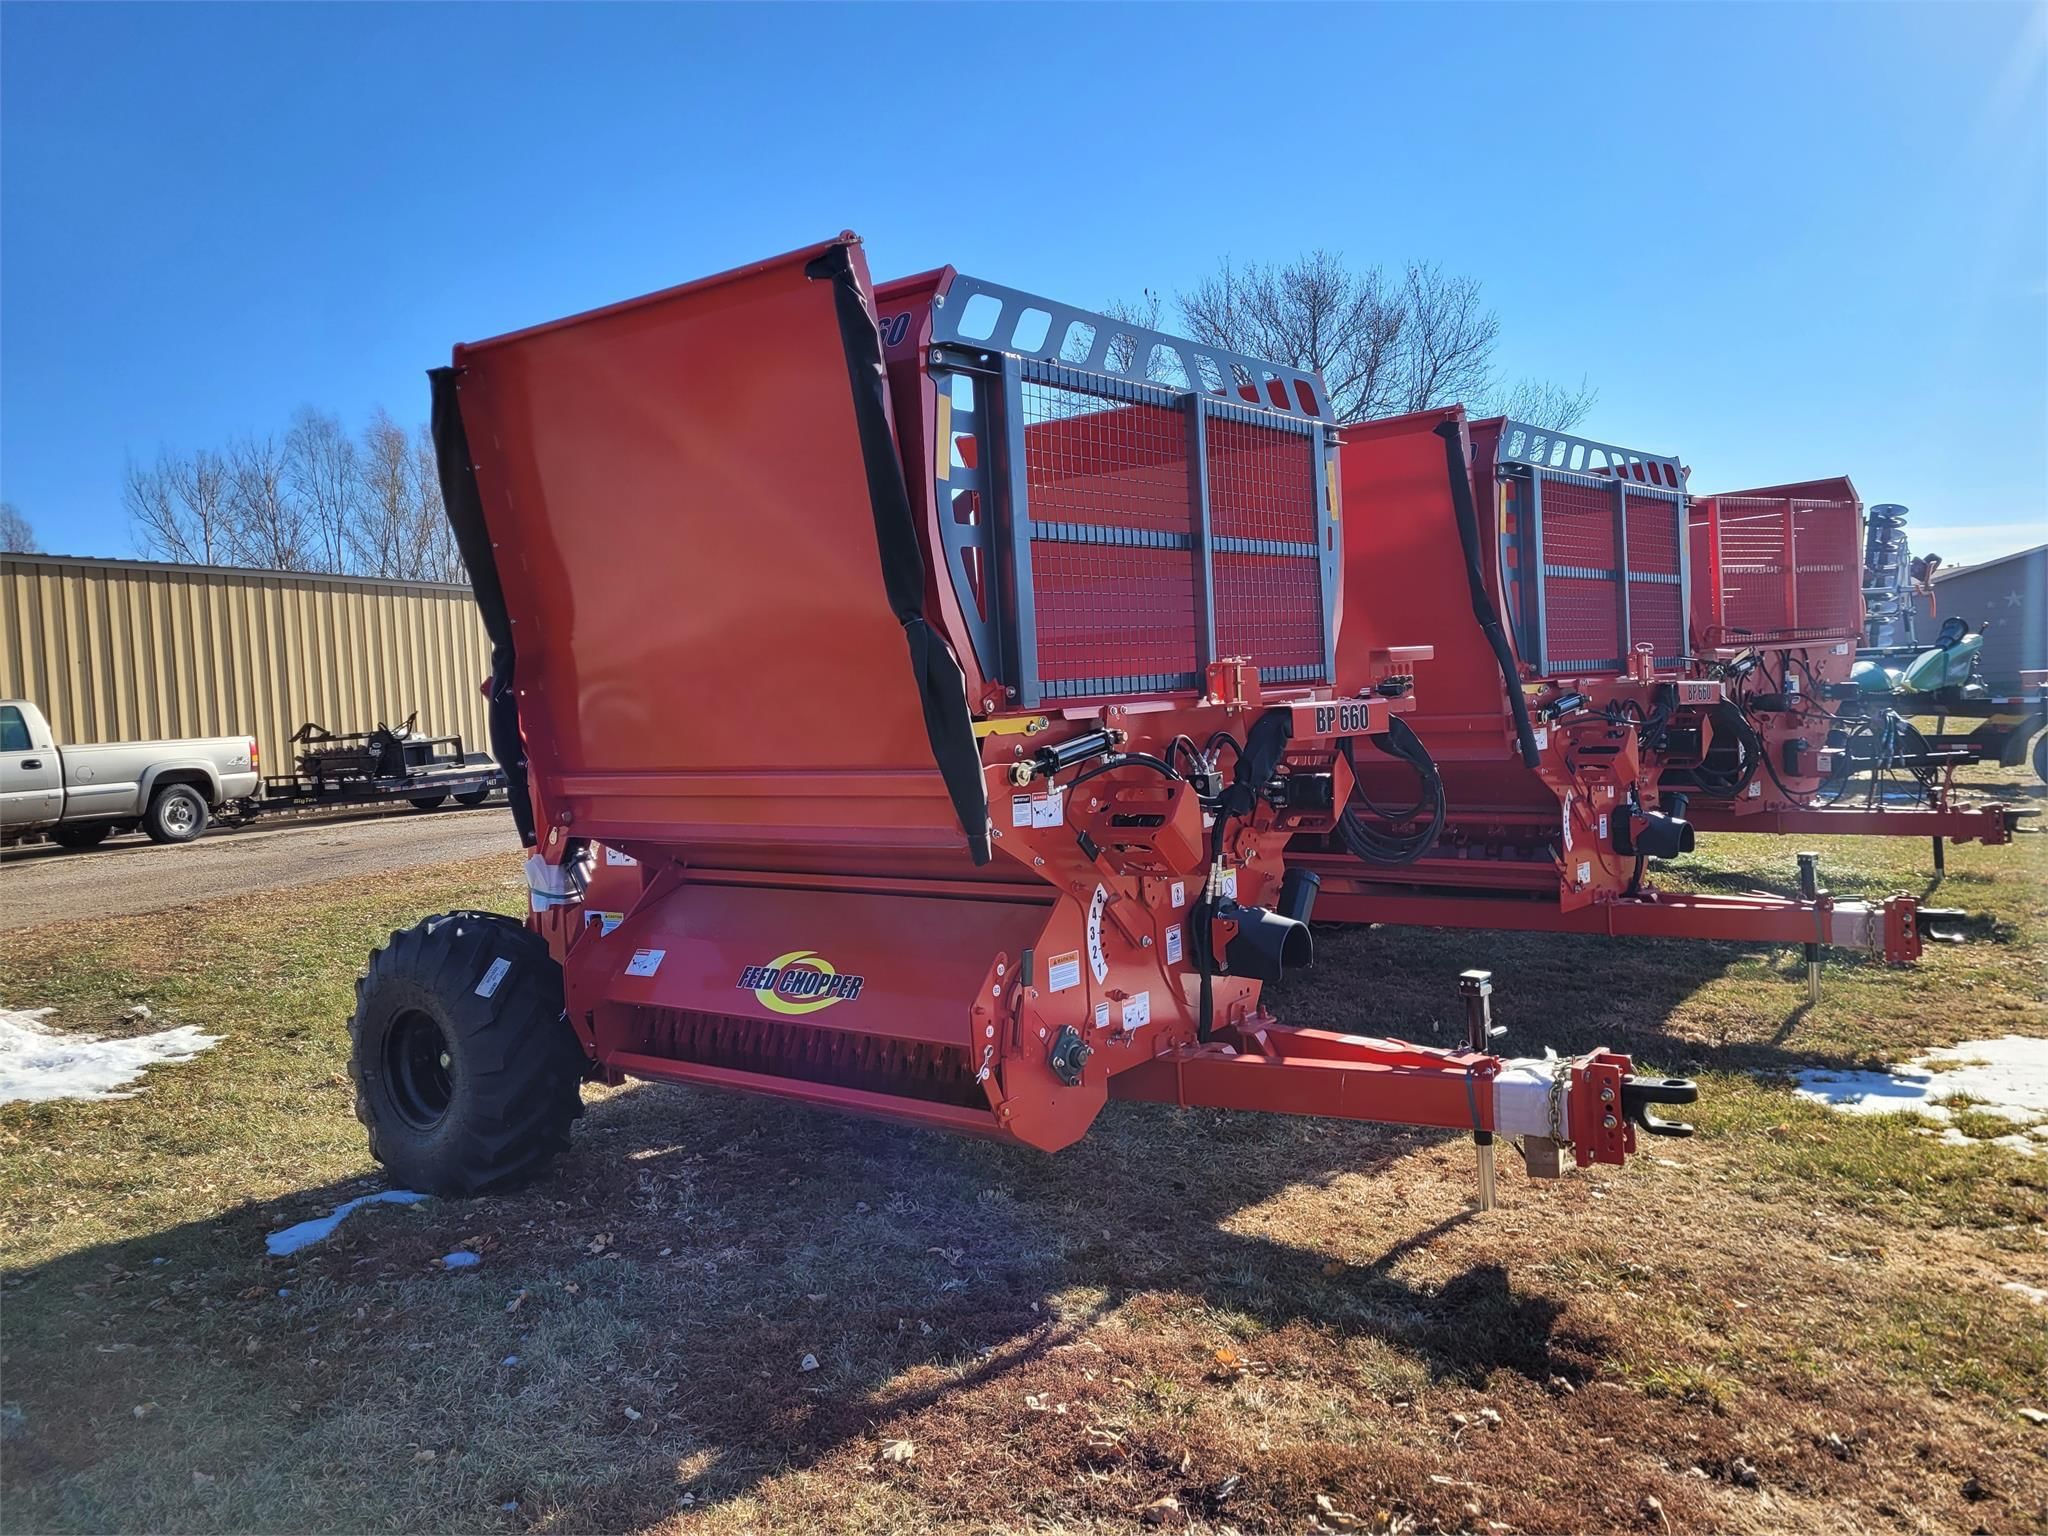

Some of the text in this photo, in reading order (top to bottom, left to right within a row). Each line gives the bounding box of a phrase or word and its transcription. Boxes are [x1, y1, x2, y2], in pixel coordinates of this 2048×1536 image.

[1315, 703, 1369, 734] BP 660
[1096, 889, 1103, 904] 5
[1091, 906, 1097, 921] 4
[1089, 926, 1096, 940] 3
[1092, 945, 1098, 960] 2
[1097, 963, 1102, 977] 1
[735, 965, 865, 1001] FEED CHOPPER
